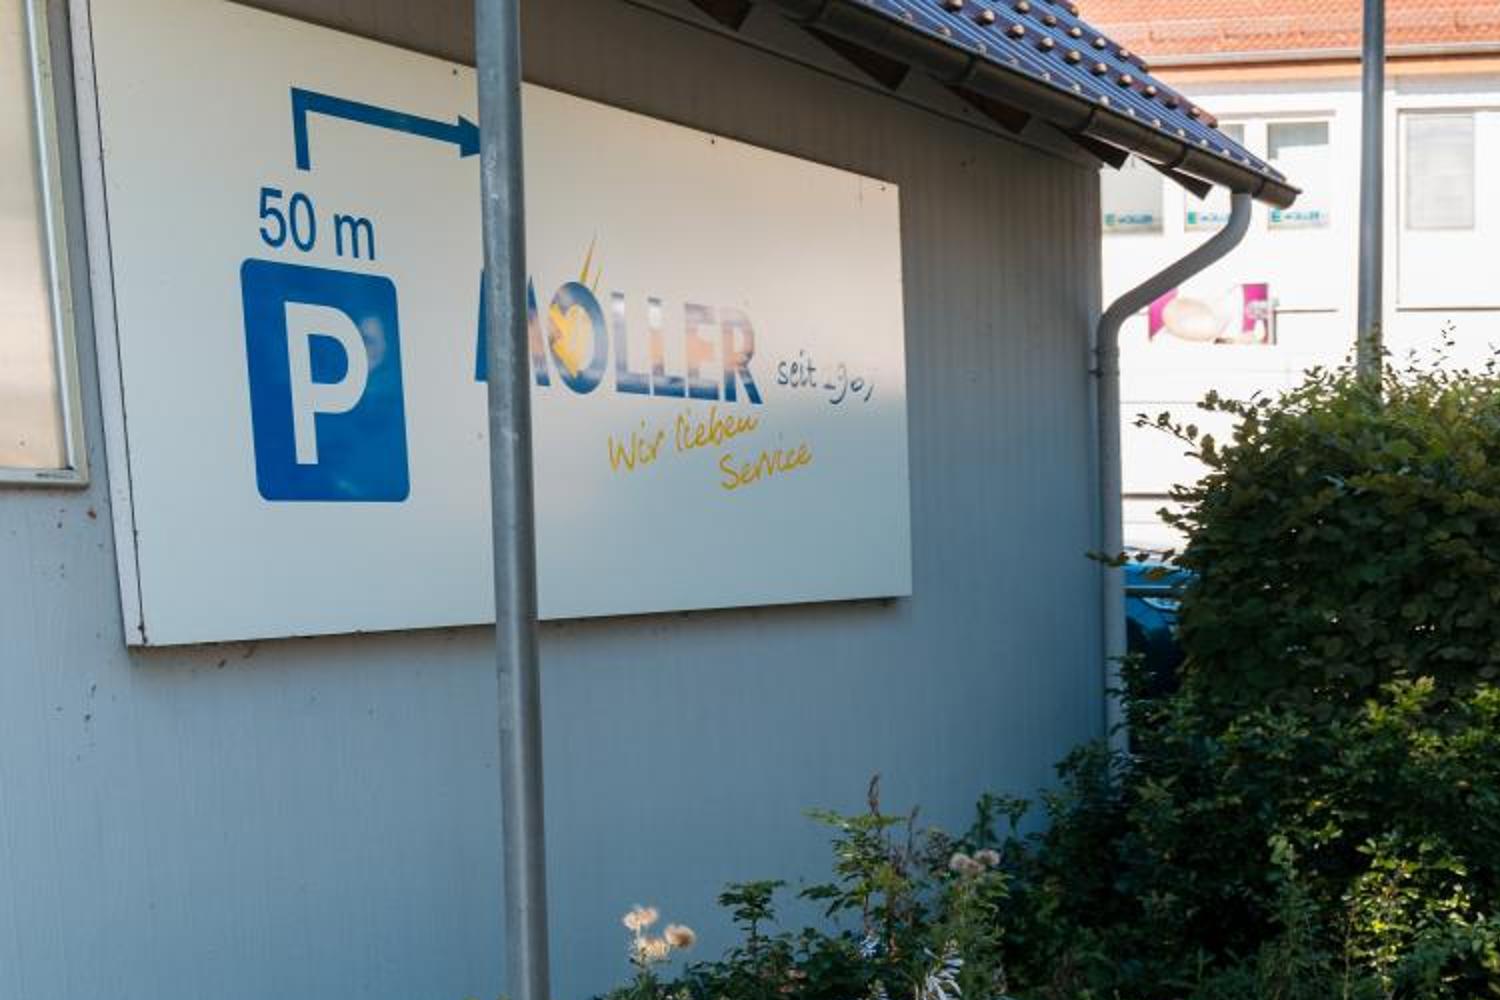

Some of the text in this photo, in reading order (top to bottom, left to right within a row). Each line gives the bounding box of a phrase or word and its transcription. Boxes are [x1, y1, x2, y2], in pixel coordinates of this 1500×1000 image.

[259, 187, 375, 261] 50 m
[284, 300, 369, 465] P
[777, 349, 817, 388] seit
[607, 405, 759, 473] Wir lieben
[718, 432, 813, 491] Service
